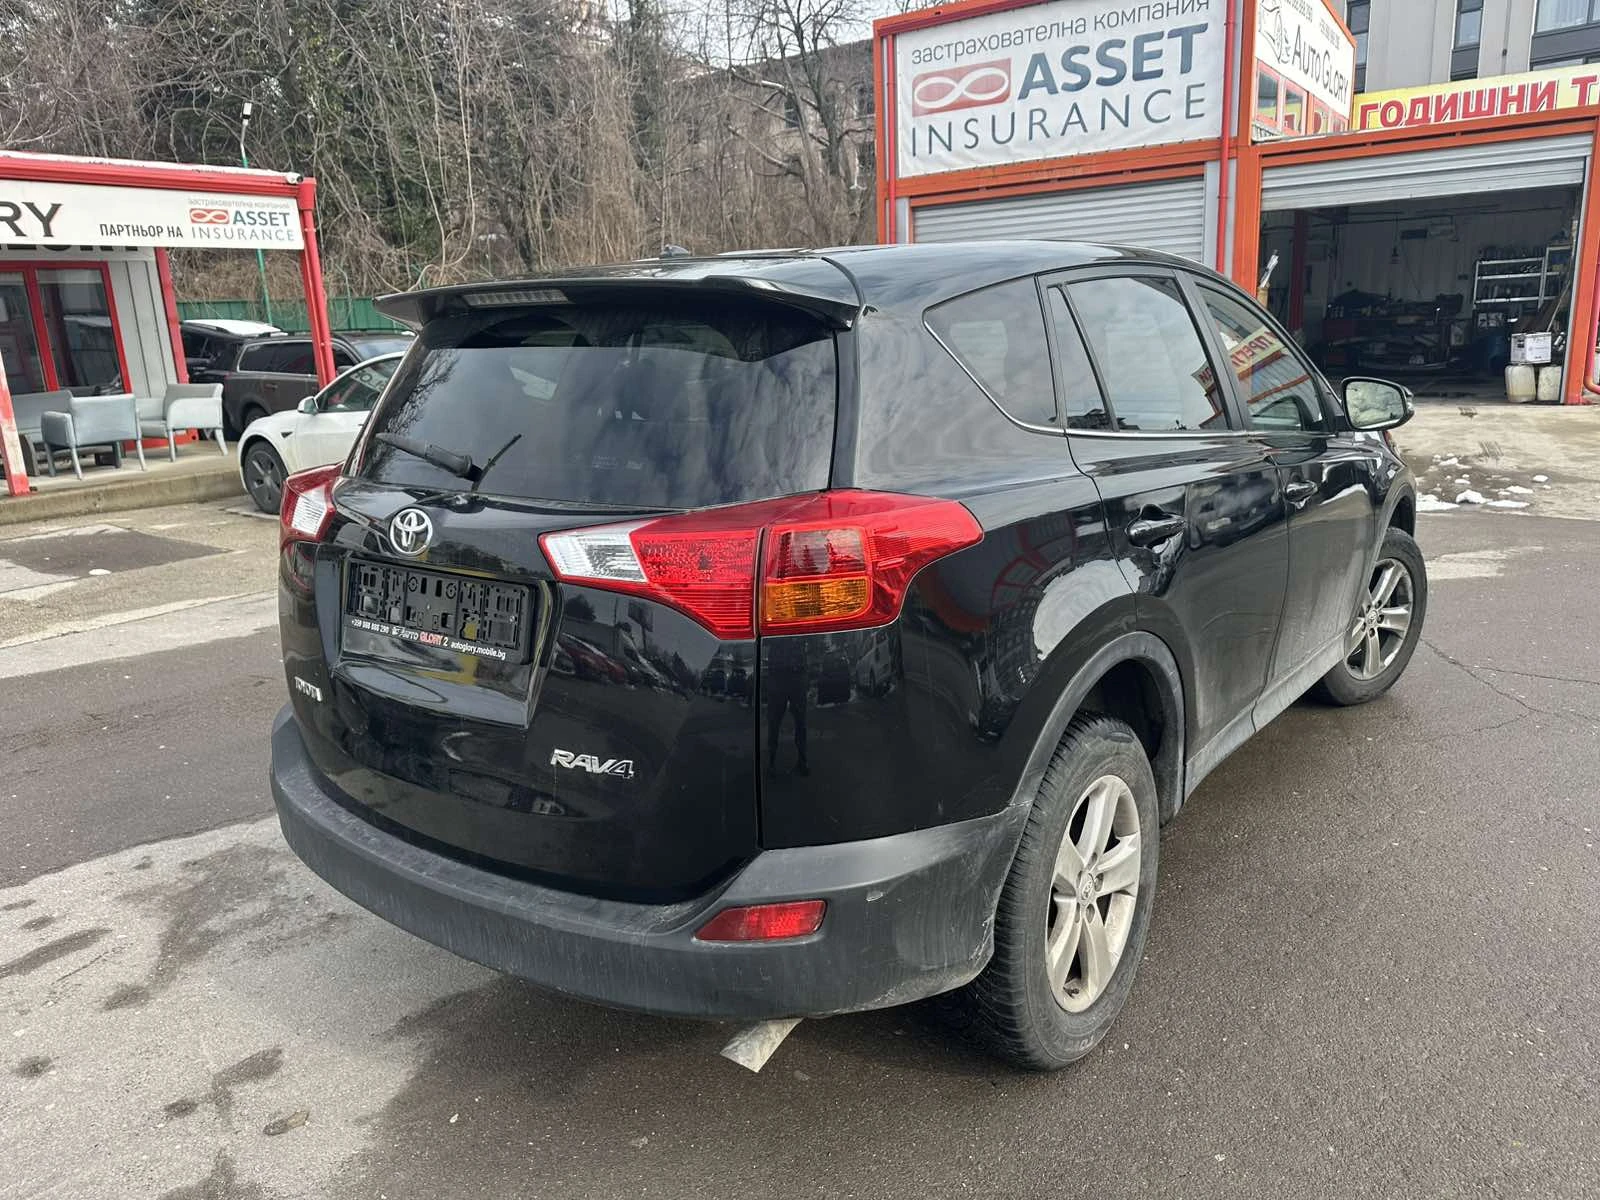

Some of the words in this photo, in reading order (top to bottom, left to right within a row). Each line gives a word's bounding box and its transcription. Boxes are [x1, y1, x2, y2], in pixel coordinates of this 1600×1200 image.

[911, 16, 1087, 64] застрахователна
[1094, 0, 1209, 34] компания
[1018, 23, 1208, 101] ASSET
[911, 83, 1206, 156] INSURANCE
[1359, 80, 1558, 130] ГОДИШНИ
[99, 223, 164, 238] ПАРТНЬОР
[166, 226, 184, 239] НА
[191, 226, 295, 241] INSURANCE
[233, 210, 290, 227] ASSET
[419, 631, 443, 646] GLORY
[443, 636, 449, 647] 2
[450, 641, 507, 660] autoglory.mobile.bg
[550, 748, 635, 780] RAV4
